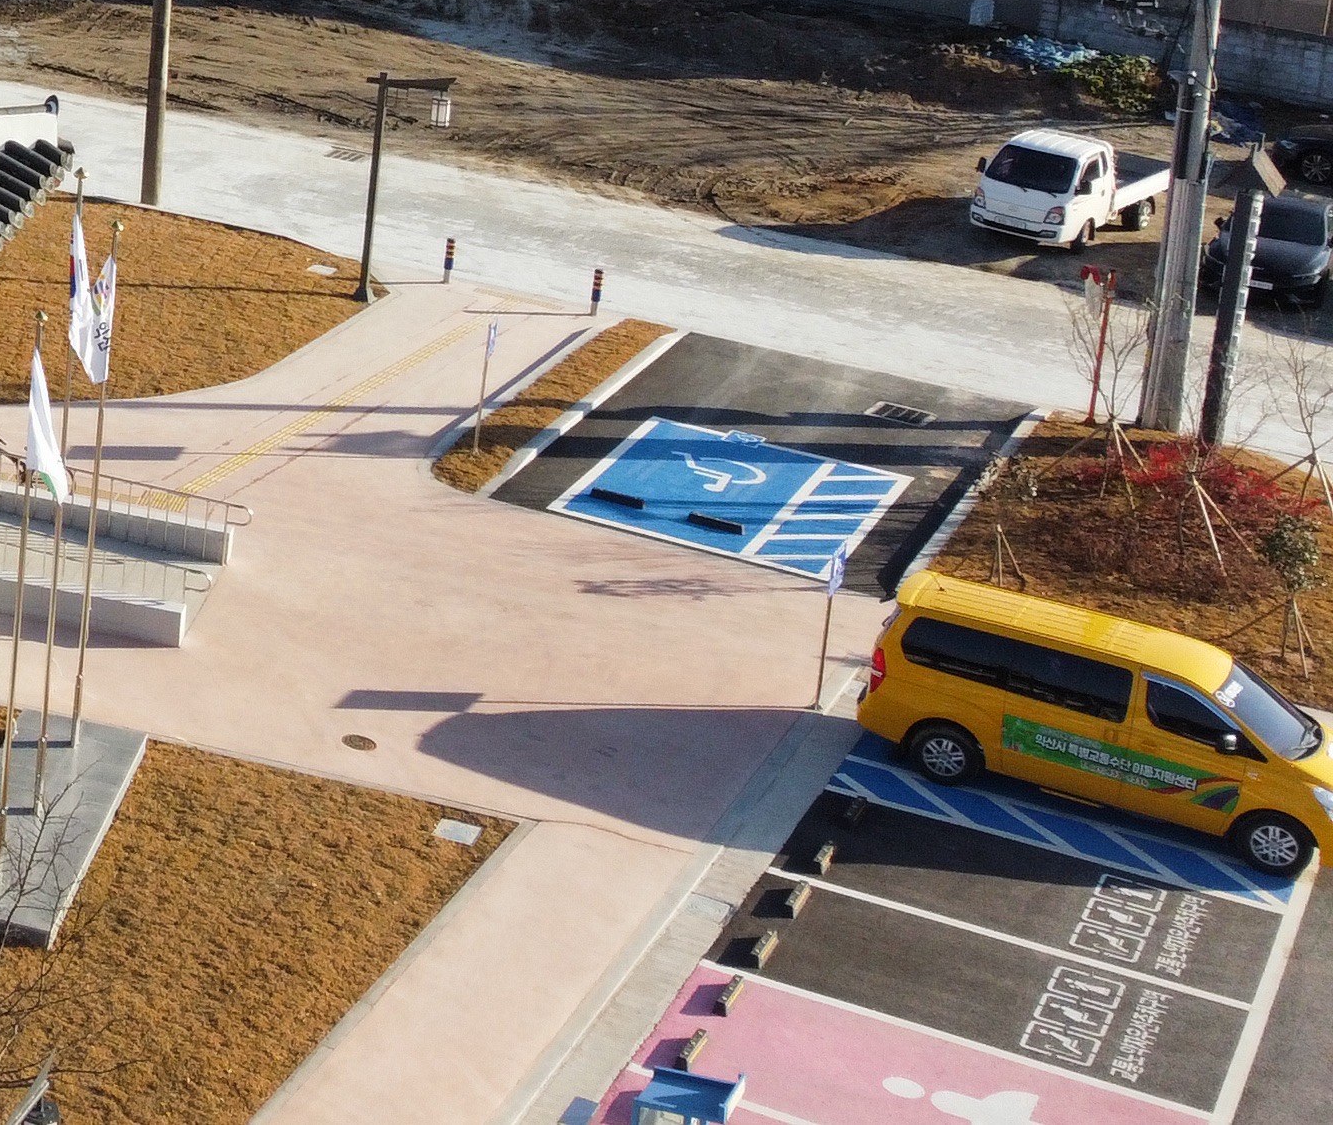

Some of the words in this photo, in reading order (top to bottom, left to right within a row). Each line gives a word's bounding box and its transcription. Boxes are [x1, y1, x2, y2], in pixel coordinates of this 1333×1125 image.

[1035, 734, 1066, 753] 익산시
[1068, 743, 1132, 772] 특별교통수단
[1132, 762, 1197, 790] 이동지원센터
